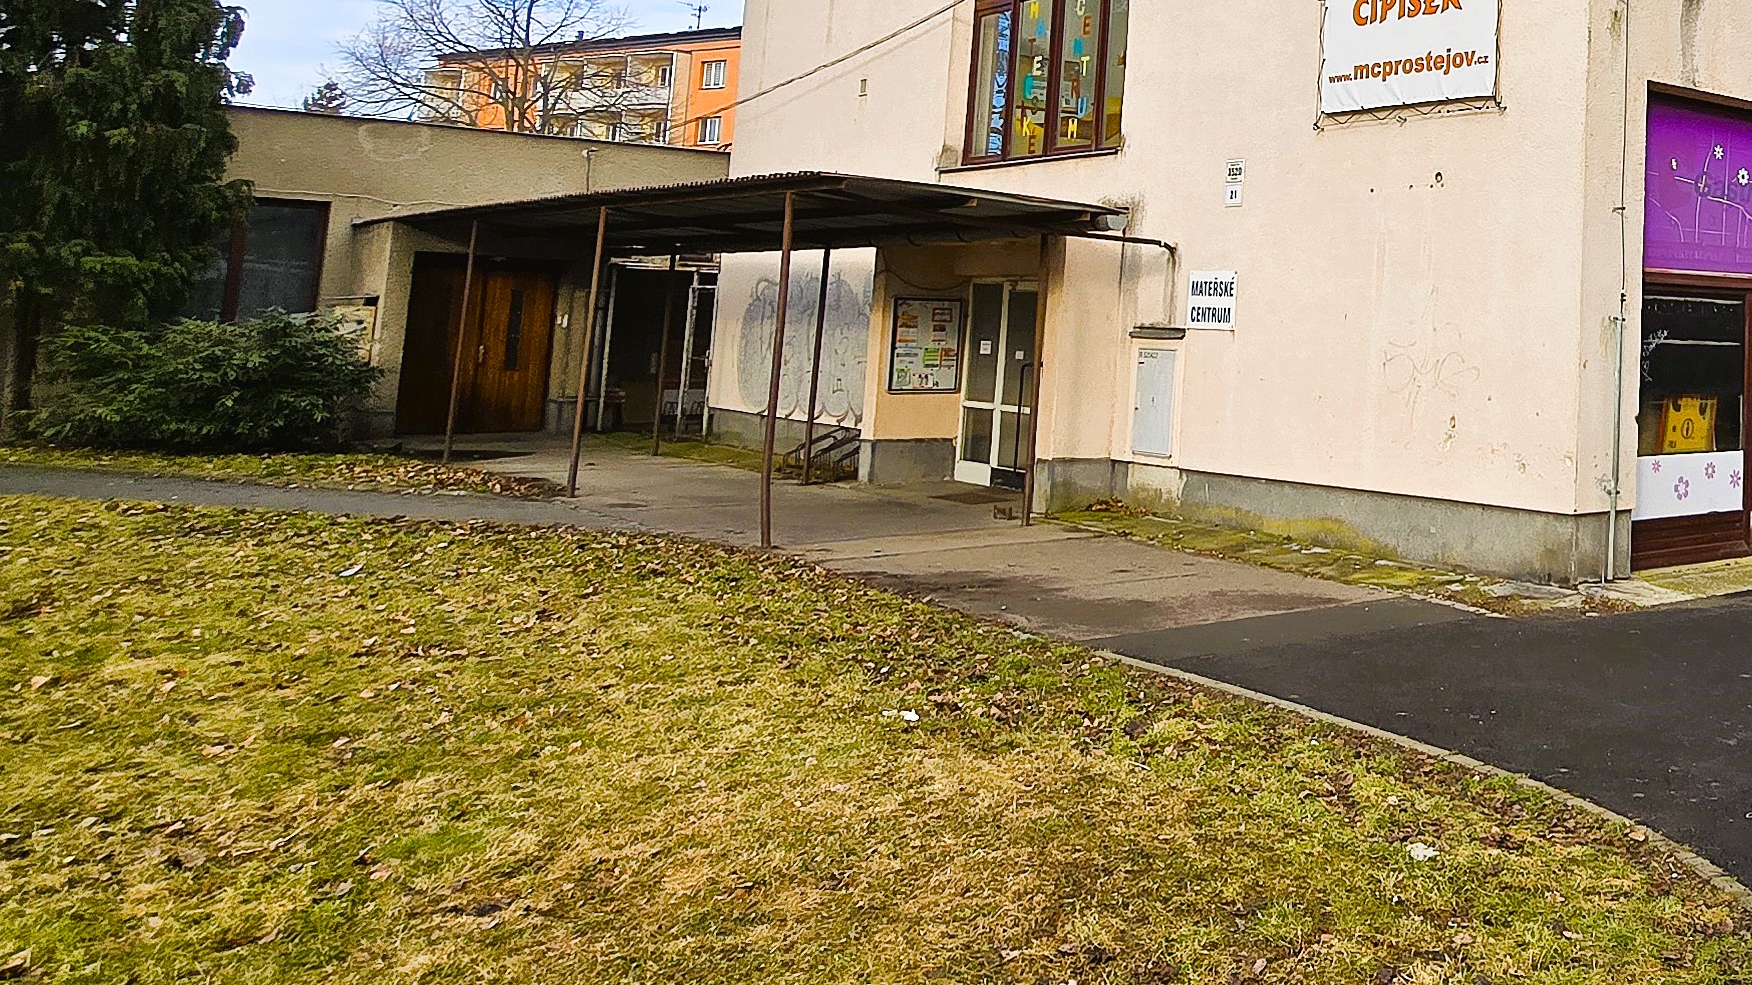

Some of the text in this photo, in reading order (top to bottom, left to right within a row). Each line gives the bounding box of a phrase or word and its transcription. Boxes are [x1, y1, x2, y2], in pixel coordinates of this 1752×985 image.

[1328, 48, 1489, 83] www.mcprostejov.cz
[1191, 276, 1235, 297] MATEŘSKÉ
[1190, 306, 1231, 324] CENTRUM
